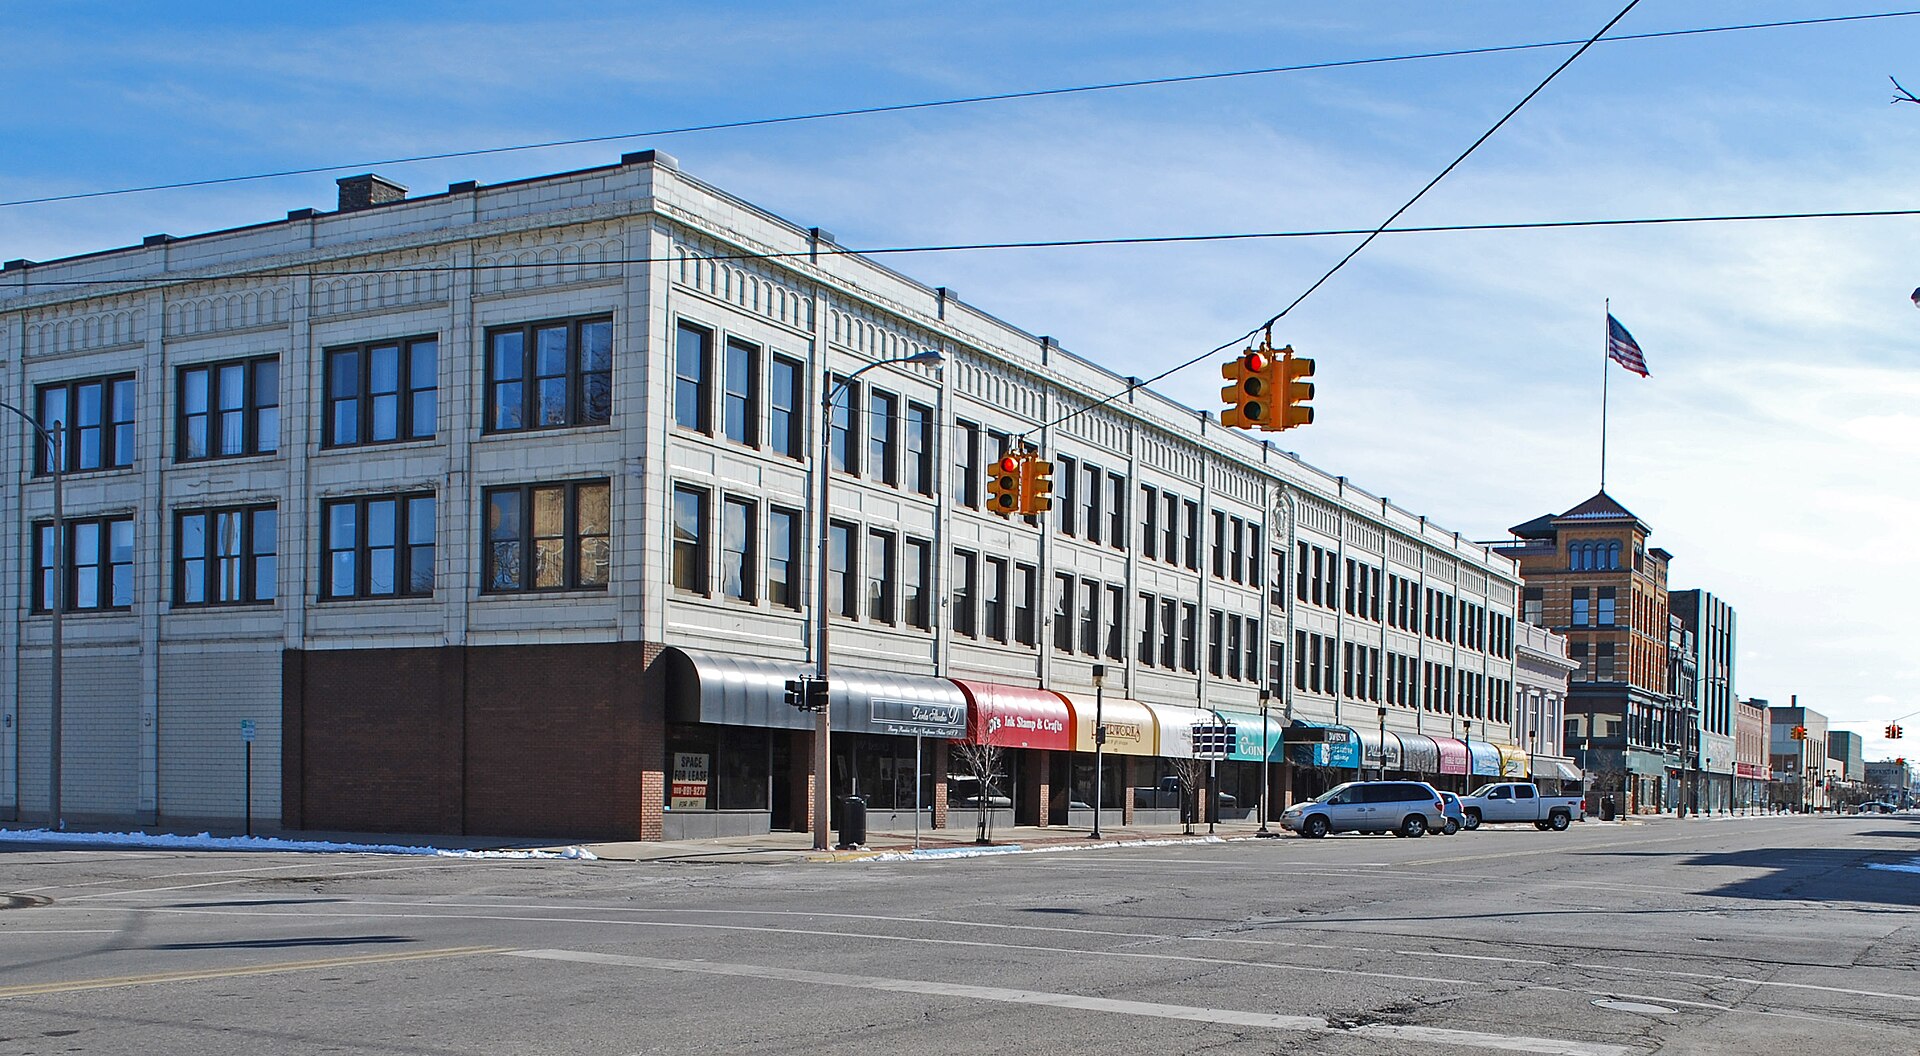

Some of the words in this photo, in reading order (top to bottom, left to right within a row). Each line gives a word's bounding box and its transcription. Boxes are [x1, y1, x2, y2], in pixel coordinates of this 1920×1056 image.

[1004, 715, 1016, 728] Ink
[1016, 716, 1036, 732] Stamp
[1037, 718, 1043, 730] &
[1043, 719, 1063, 734] Crafts
[681, 756, 702, 768] SPACE
[675, 770, 686, 780] FOR
[688, 770, 707, 781] LEASE
